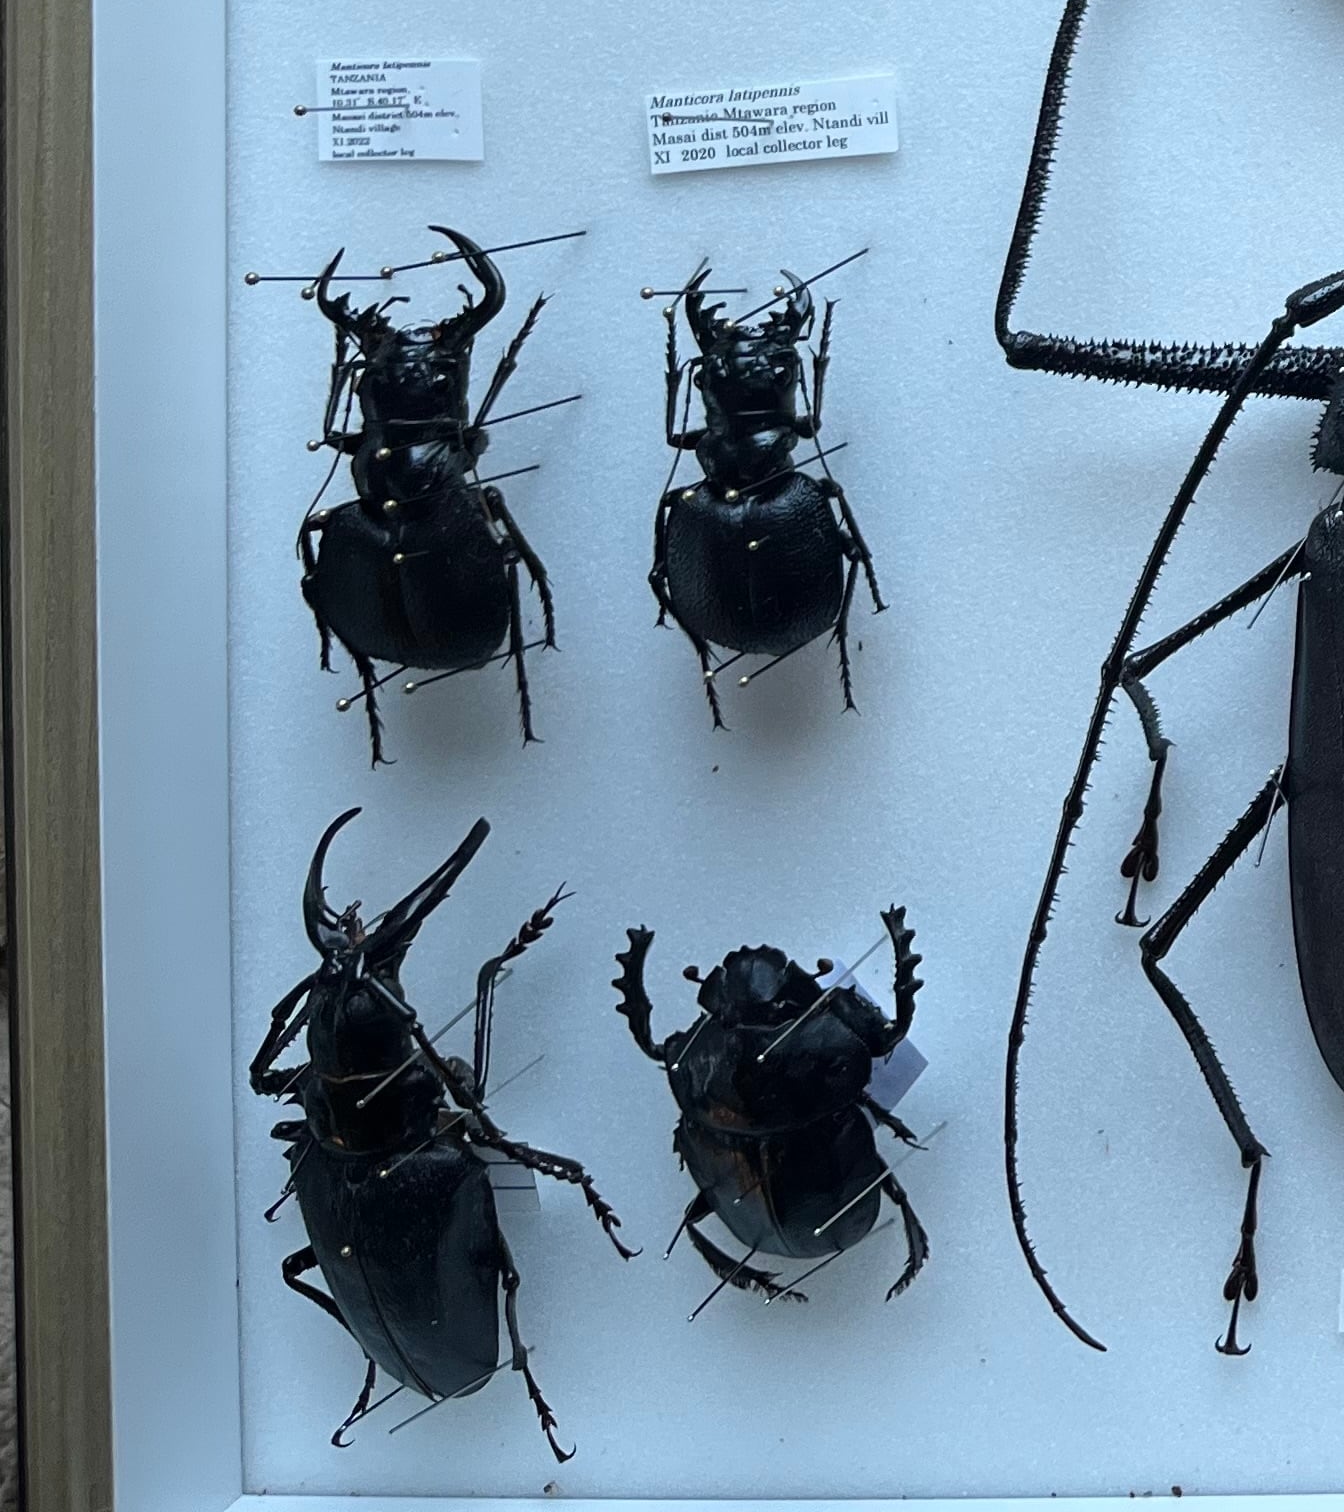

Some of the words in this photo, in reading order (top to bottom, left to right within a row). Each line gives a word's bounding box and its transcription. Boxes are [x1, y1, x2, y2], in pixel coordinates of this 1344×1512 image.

[329, 73, 387, 84] TANZANIA
[650, 94, 725, 110] Manticora
[728, 85, 801, 106] latipennis
[723, 106, 788, 121] Mtawara
[792, 101, 836, 117] region
[652, 129, 697, 146] Masai
[701, 127, 728, 143] dist
[732, 125, 771, 139] 504m
[775, 120, 809, 135] elev.
[813, 114, 863, 132] Ntandi
[866, 111, 890, 126] vill
[654, 150, 671, 165] XI
[681, 147, 716, 163] 2020
[726, 142, 759, 158] local
[763, 138, 823, 155] collector
[827, 134, 849, 149] leg
